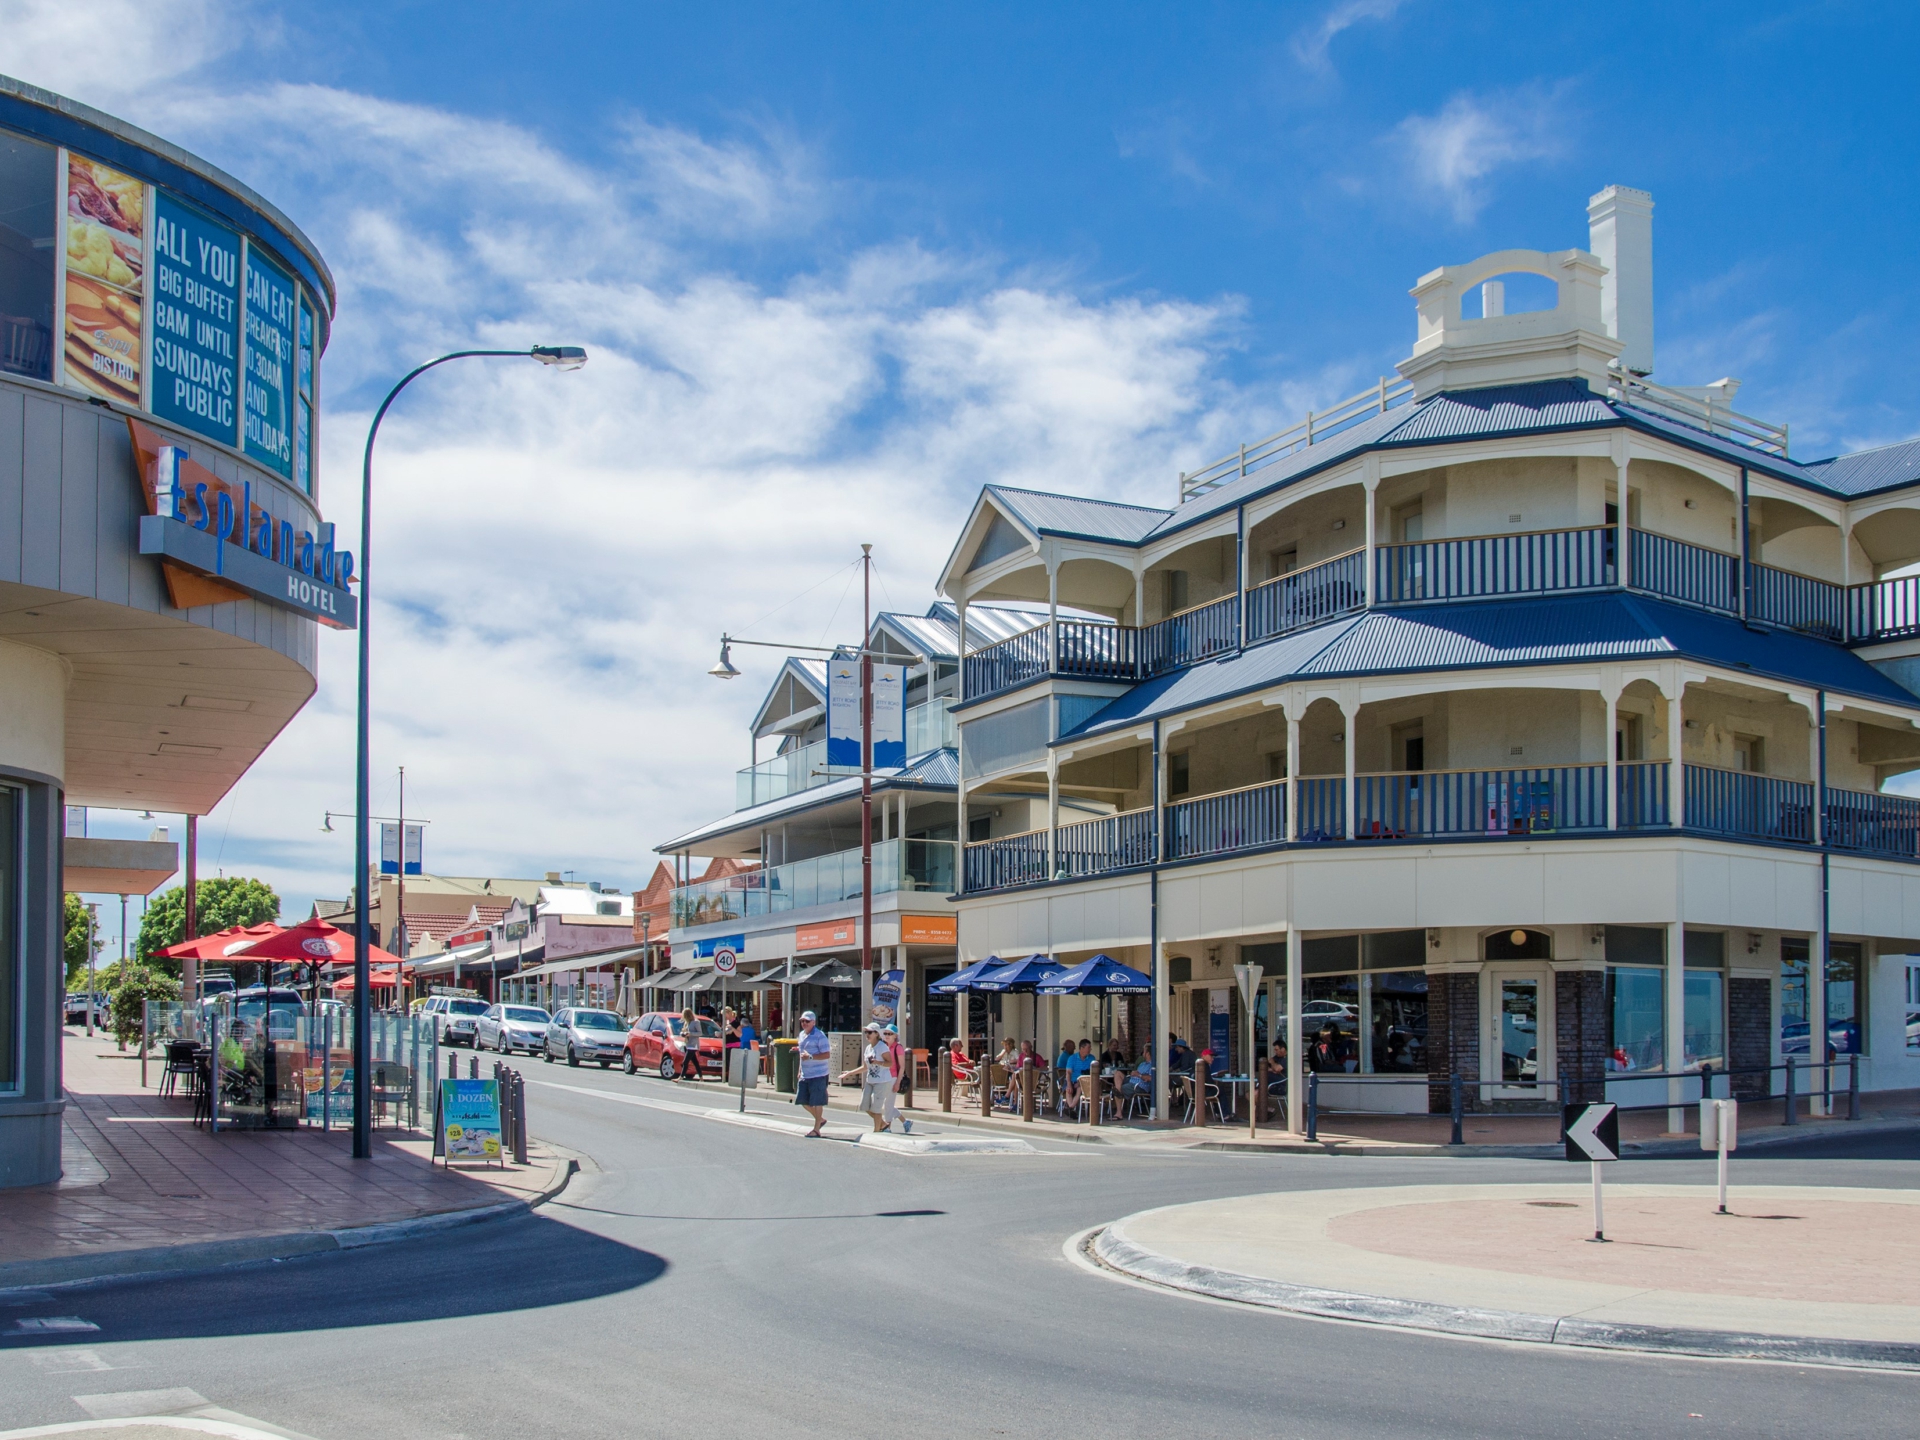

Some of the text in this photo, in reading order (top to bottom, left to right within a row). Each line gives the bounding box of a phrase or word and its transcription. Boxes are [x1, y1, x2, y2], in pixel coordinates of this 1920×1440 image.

[156, 216, 191, 267] ALL
[198, 237, 236, 288] YOU
[245, 263, 269, 313] CAN
[271, 284, 294, 332] EAT
[159, 264, 182, 298] BIG
[185, 278, 234, 323] BUFFET
[245, 308, 292, 364] BREAKFAST
[92, 352, 133, 382] BISTRO
[154, 336, 268, 417] SUNDAYS AND
[156, 301, 282, 391] 8AM UNTIL 10.30AM
[174, 378, 233, 427] PUBLIC
[245, 409, 290, 463] HOLIDAYS
[168, 446, 354, 594] Esplanade
[288, 575, 337, 615] HOTEL
[719, 956, 732, 966] 40
[448, 1094, 493, 1103] 1 DOZEN
